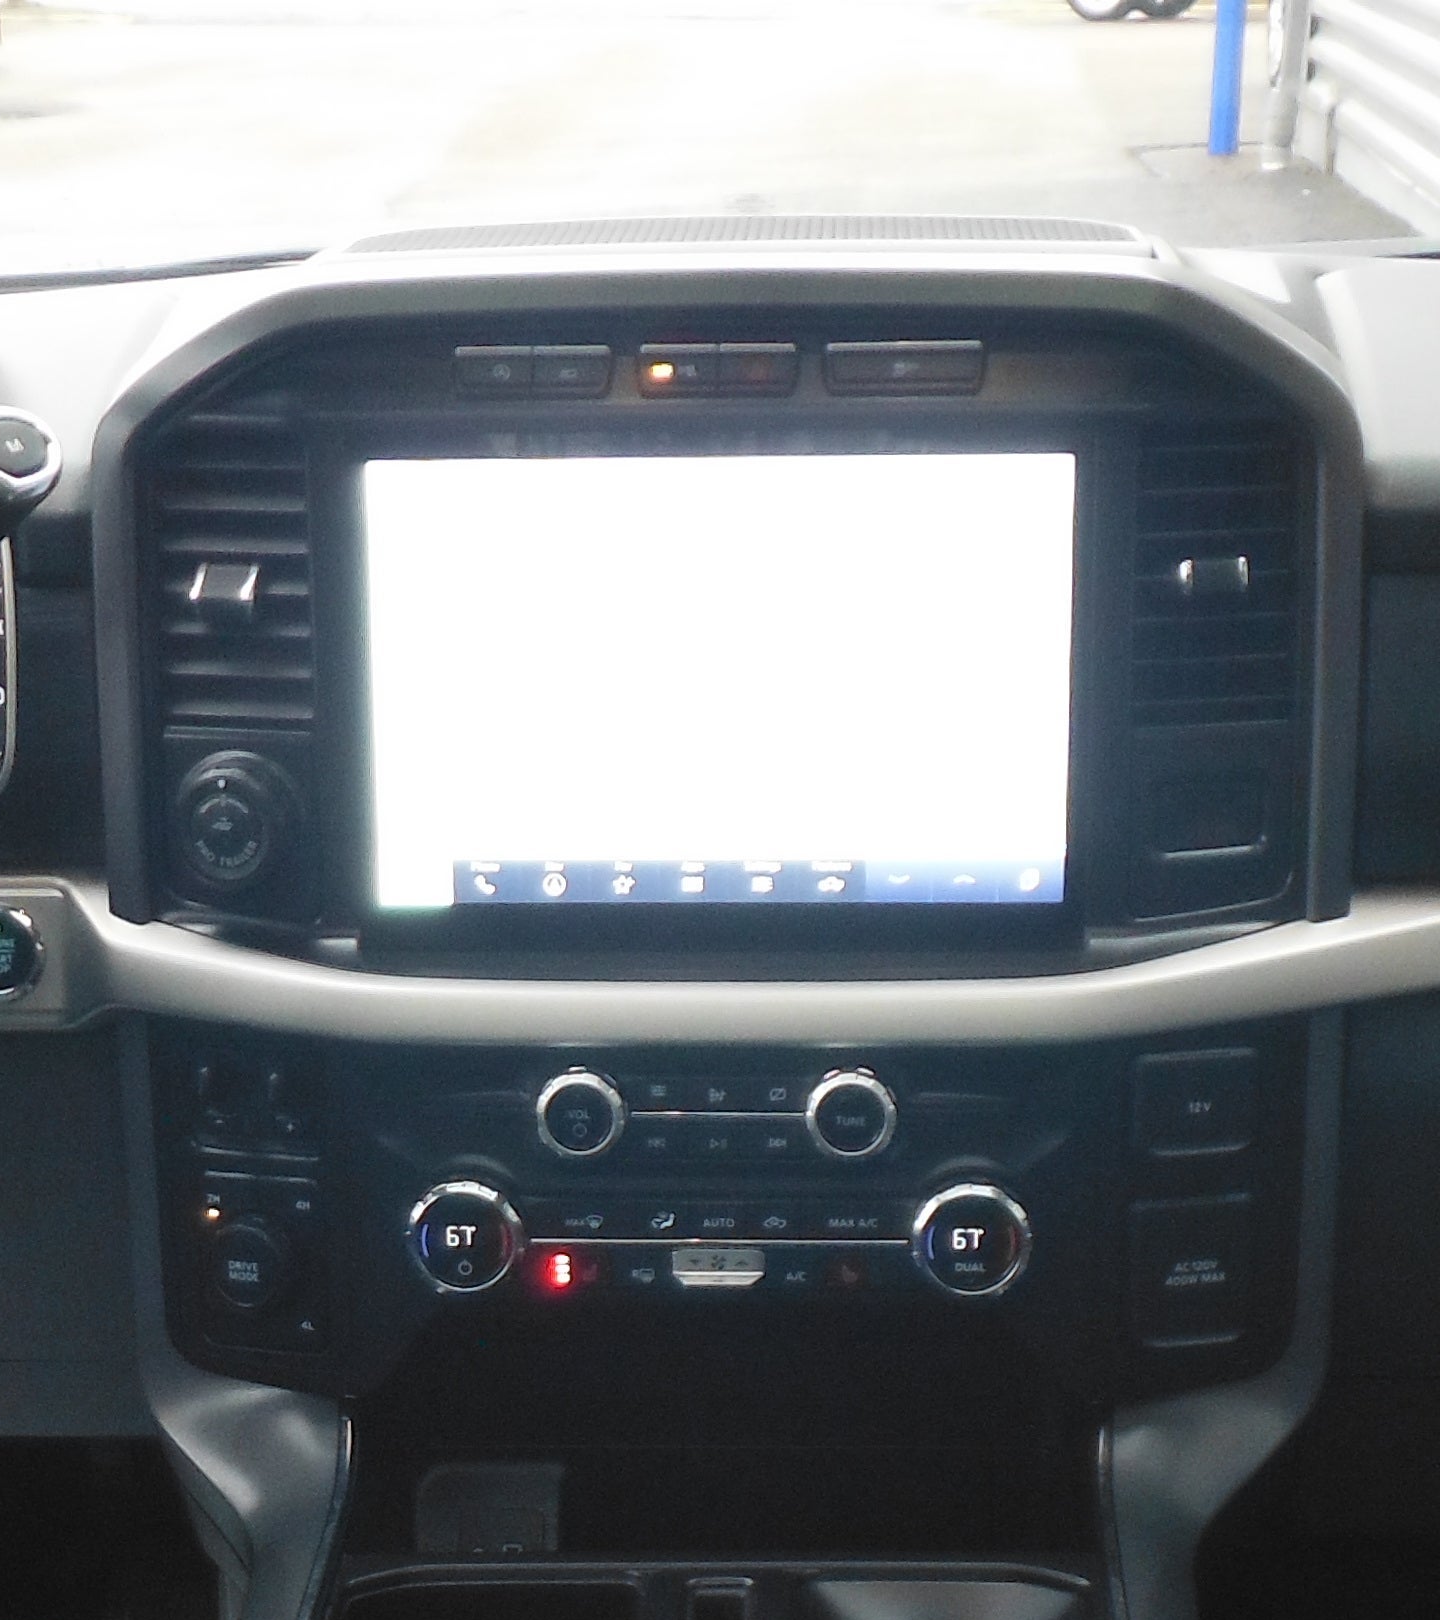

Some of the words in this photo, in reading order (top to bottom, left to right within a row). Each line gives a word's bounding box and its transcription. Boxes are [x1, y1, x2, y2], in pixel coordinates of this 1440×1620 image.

[836, 1115, 866, 1126] TUNE
[703, 1217, 736, 1228] AUTO
[829, 1218, 856, 1228] MAX
[859, 1218, 879, 1228] A/C
[227, 1260, 259, 1272] DRIVE
[954, 1262, 987, 1273] DUAL
[228, 1270, 260, 1282] MODE
[786, 1270, 808, 1281] A/C
